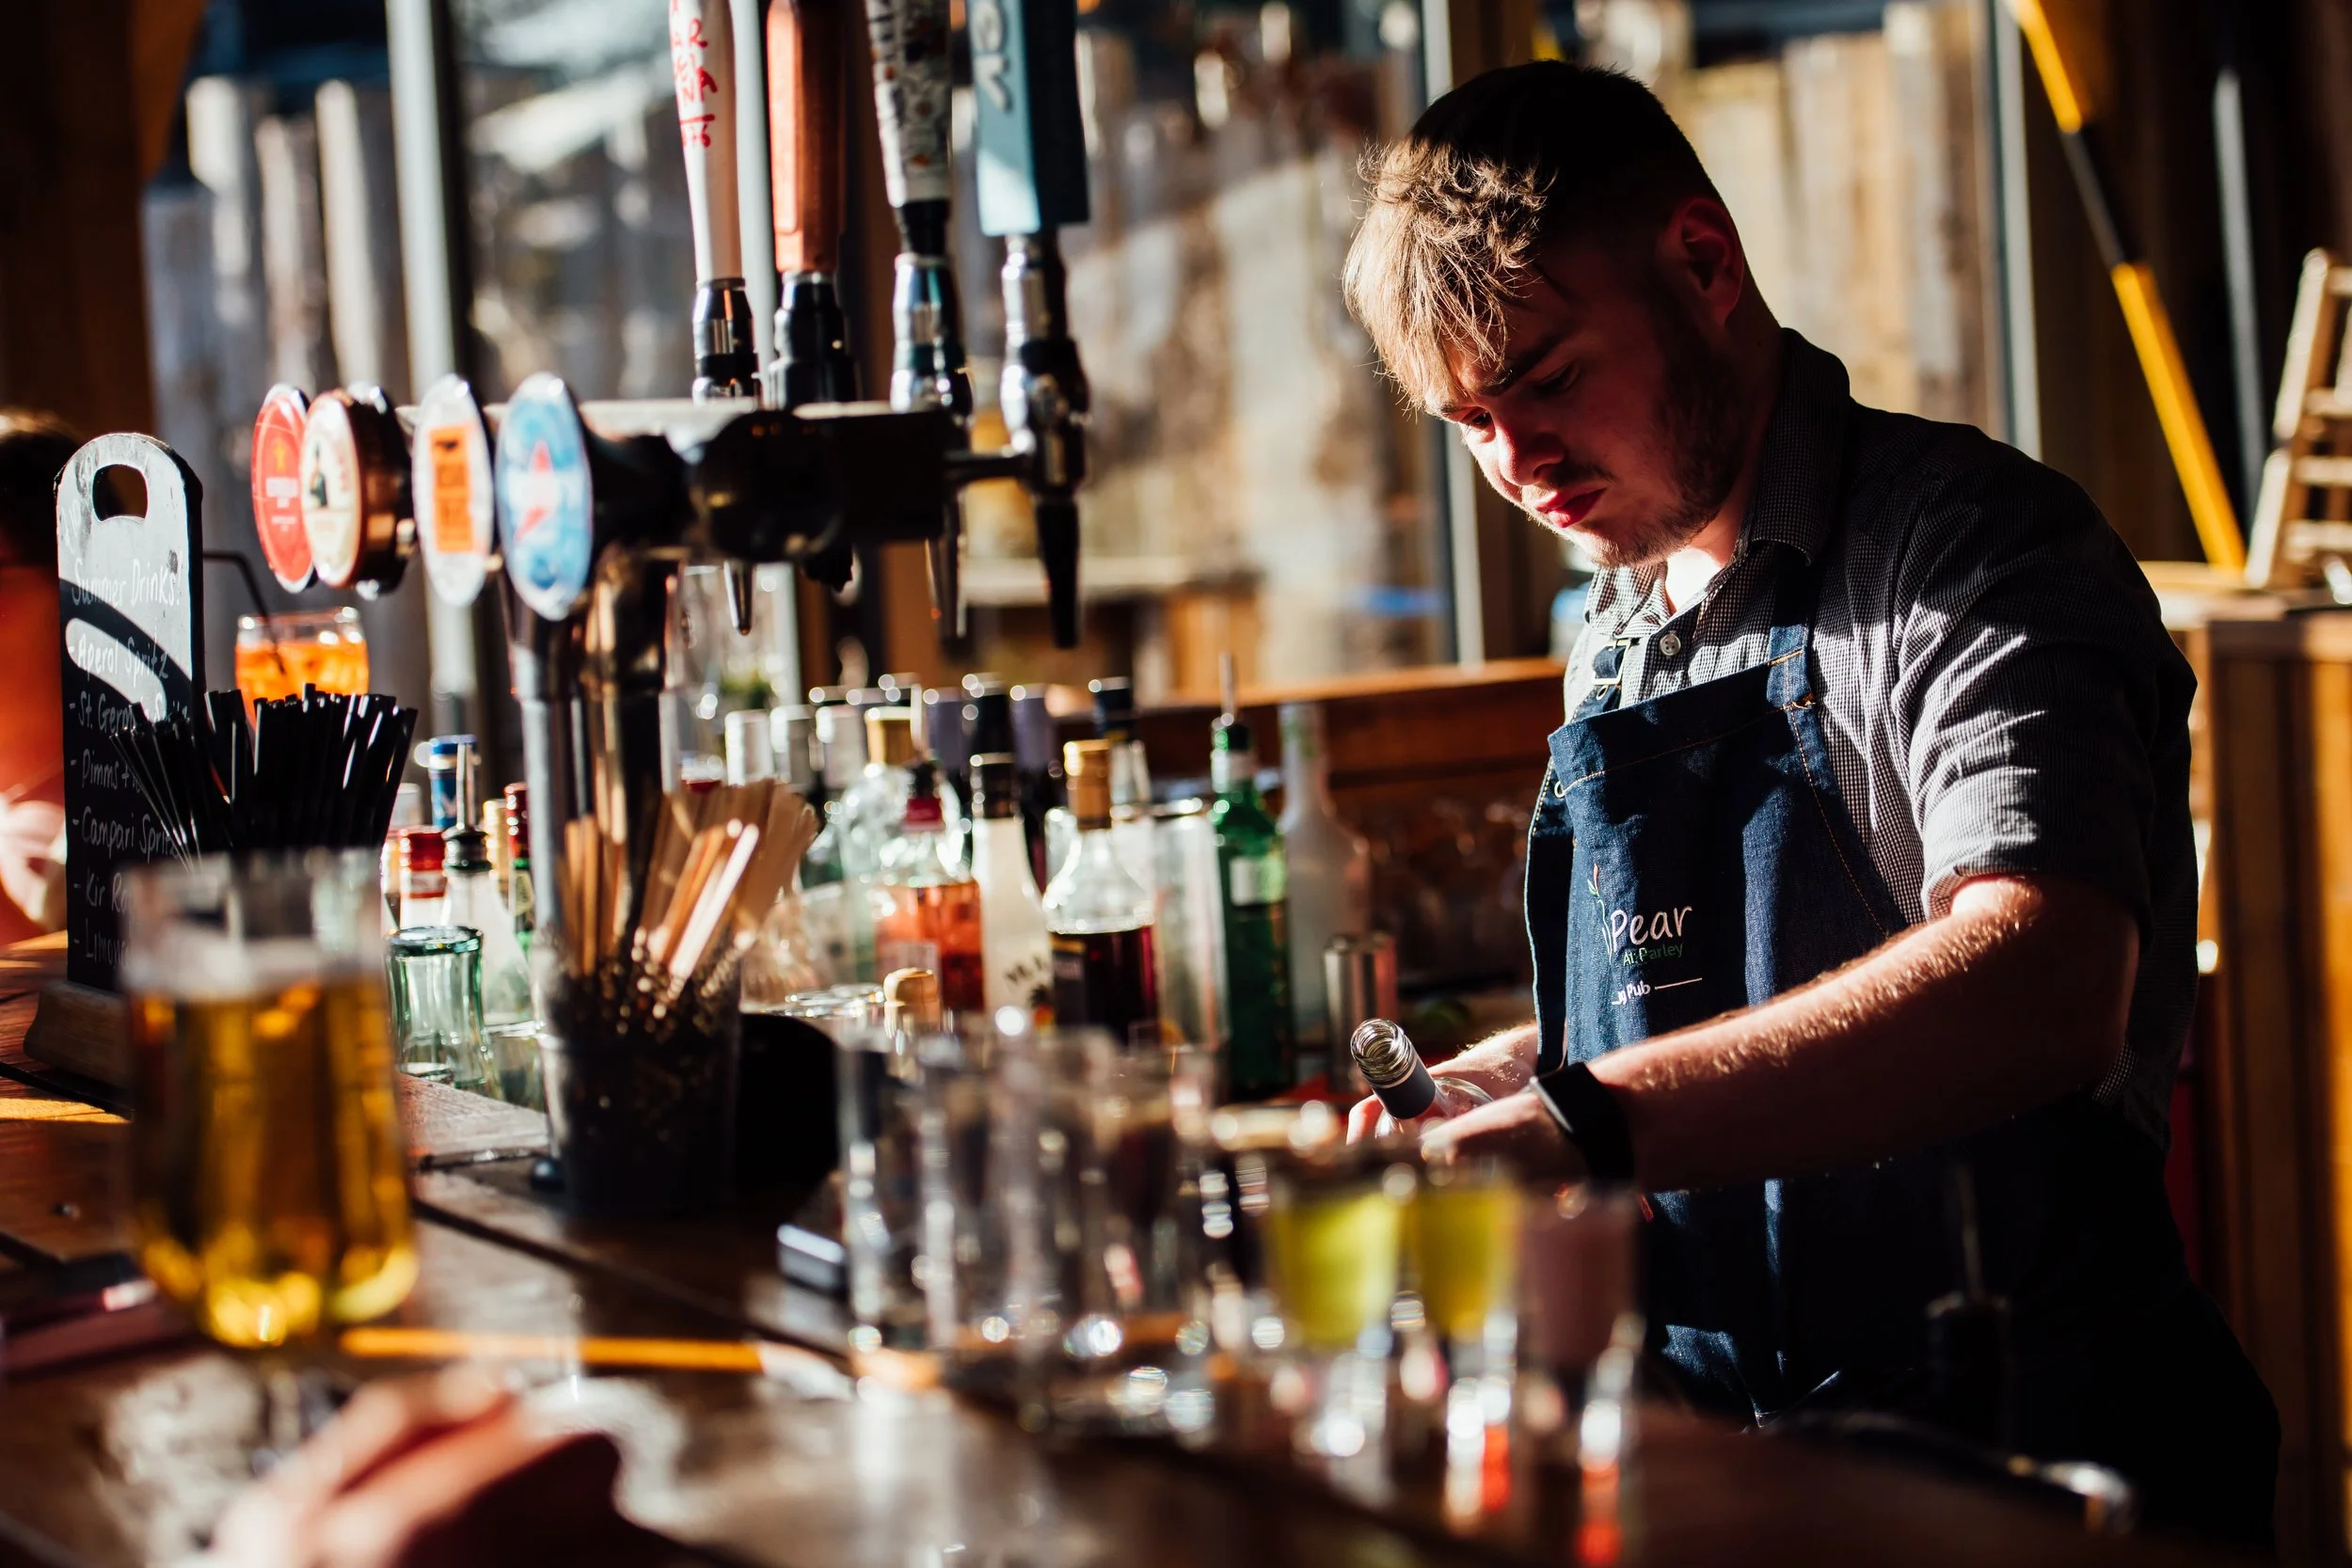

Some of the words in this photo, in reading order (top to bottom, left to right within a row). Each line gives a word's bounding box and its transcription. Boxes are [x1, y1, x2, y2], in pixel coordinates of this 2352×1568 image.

[72, 557, 127, 607] Summer
[1610, 905, 1692, 953] Pear
[1638, 943, 1683, 962] Parley
[1626, 979, 1651, 1000] Pub
